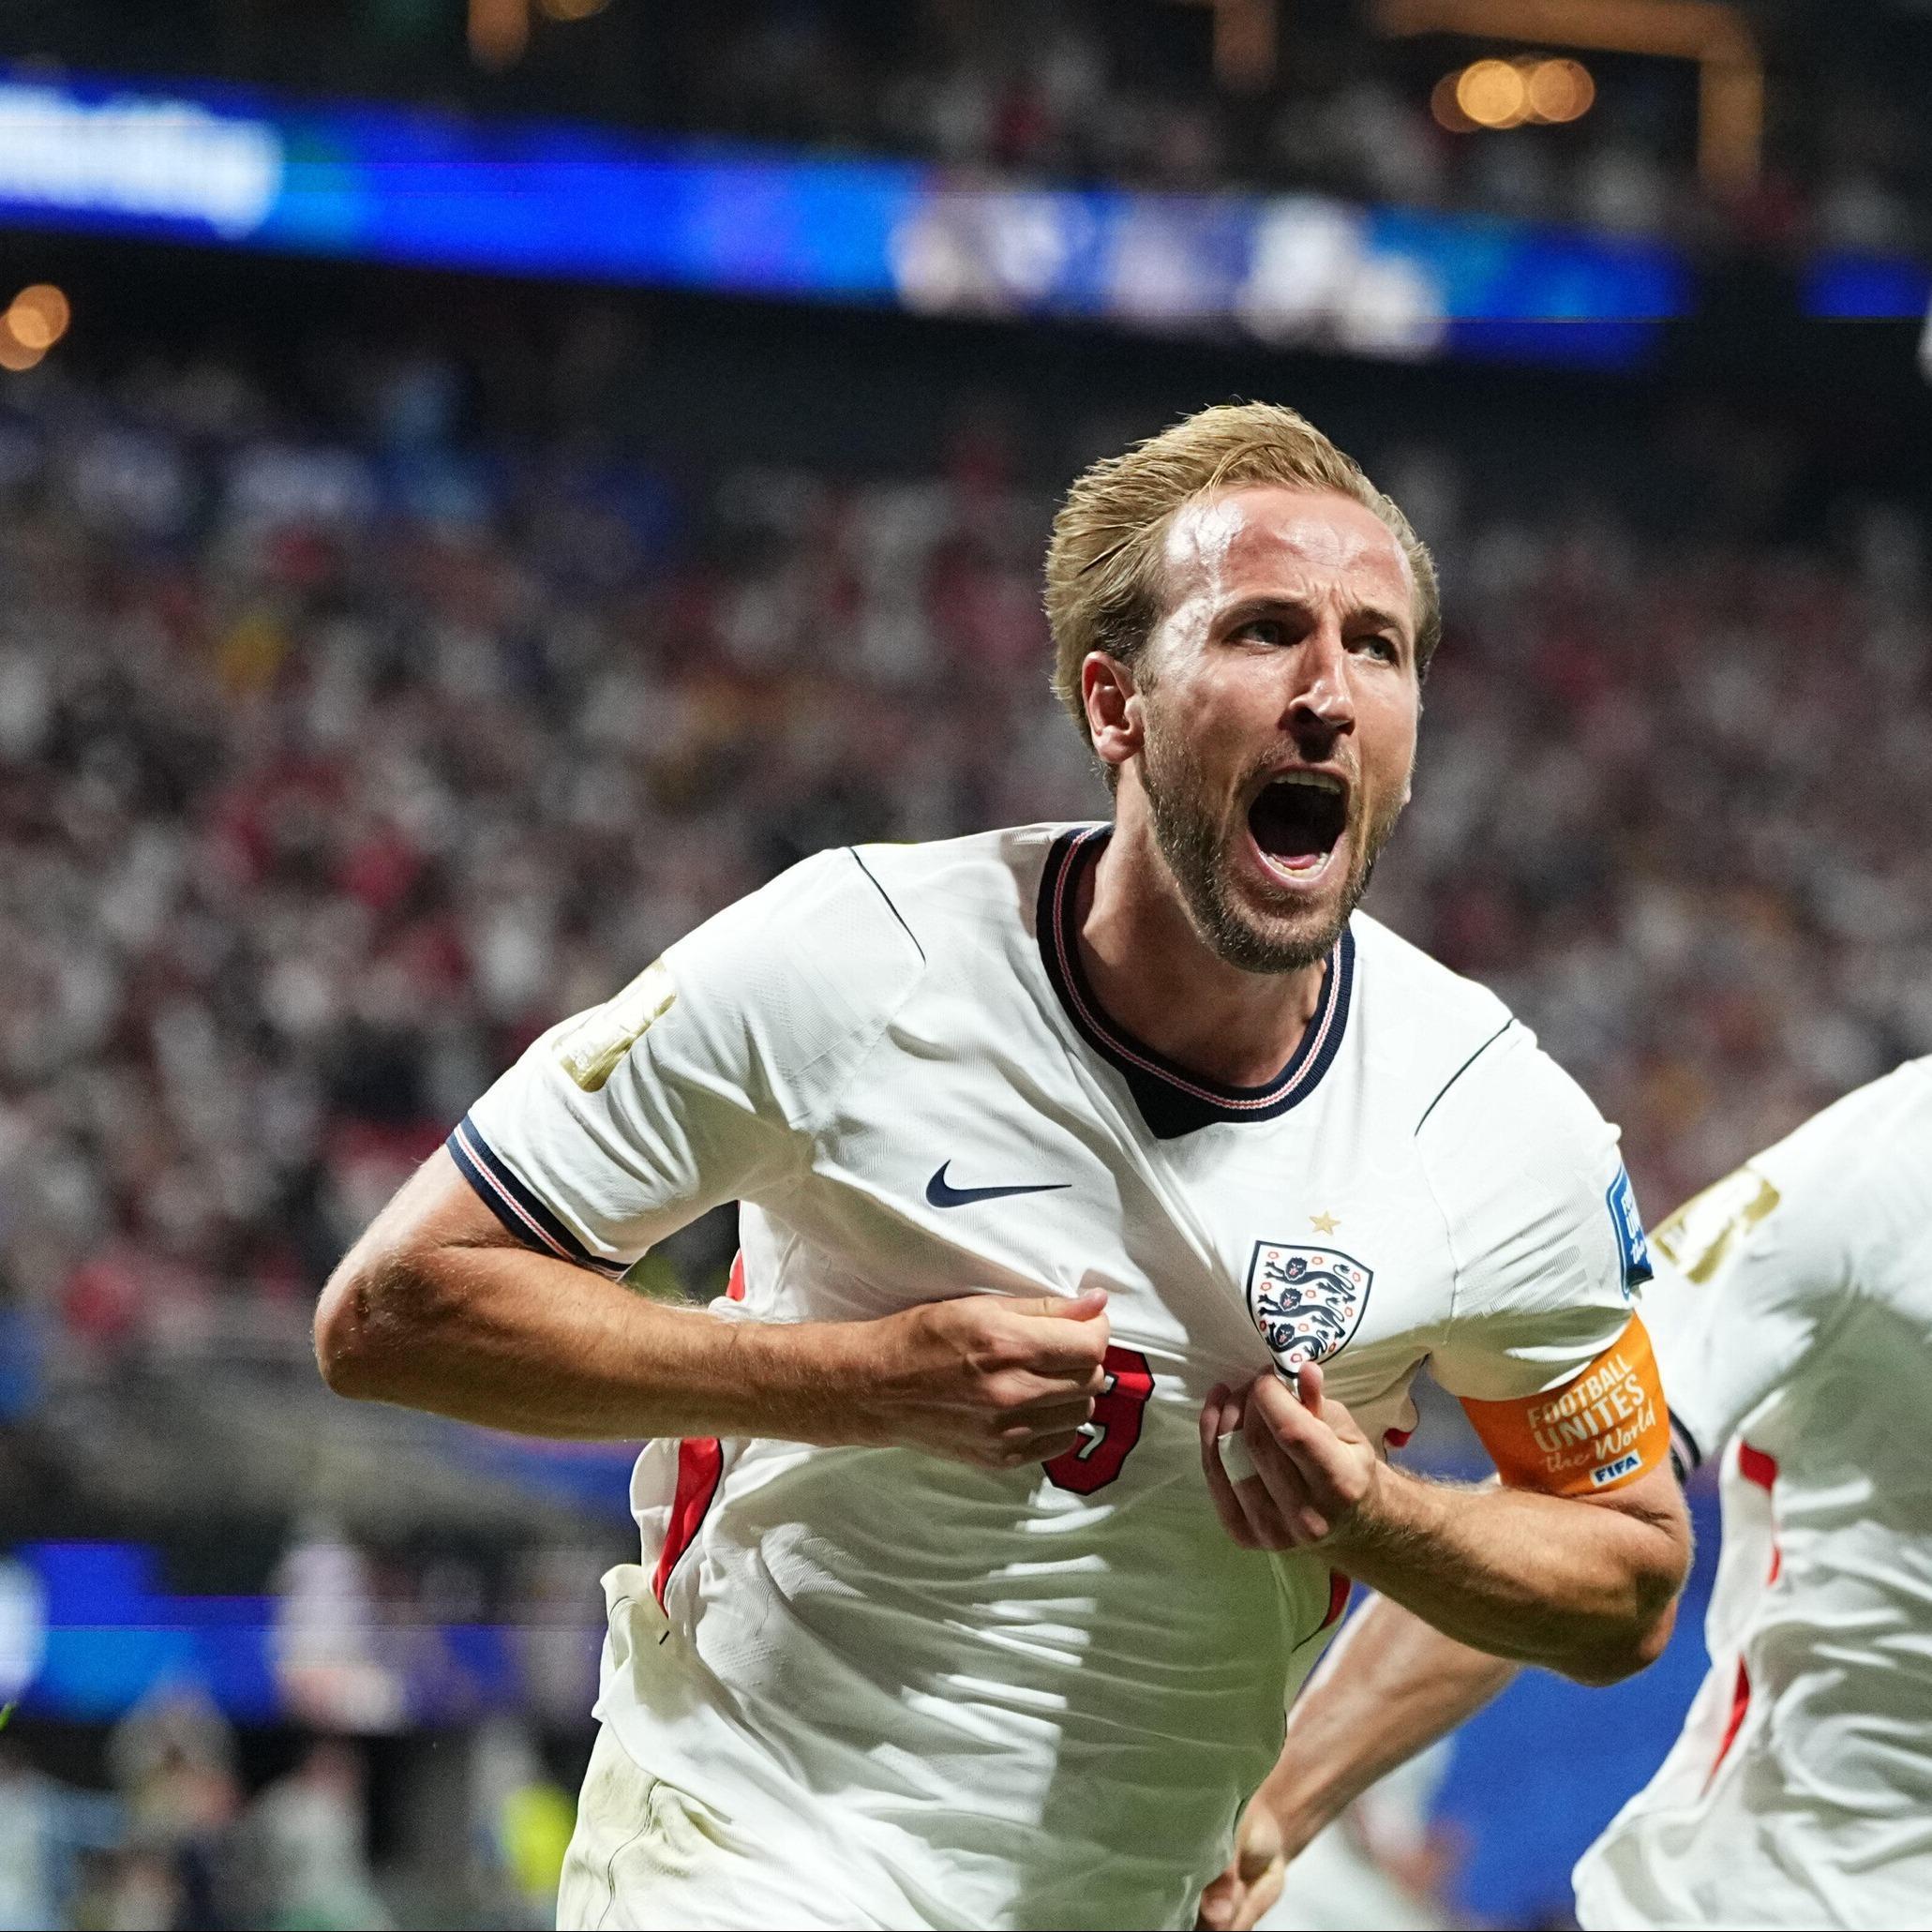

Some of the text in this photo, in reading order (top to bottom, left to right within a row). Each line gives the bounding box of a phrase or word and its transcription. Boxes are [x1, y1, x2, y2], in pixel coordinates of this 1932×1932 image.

[1527, 1354, 1633, 1430] FOOTBALL
[1534, 1373, 1645, 1453] UNITES
[1540, 1398, 1656, 1473] the World
[1594, 1455, 1639, 1483] FIFA
